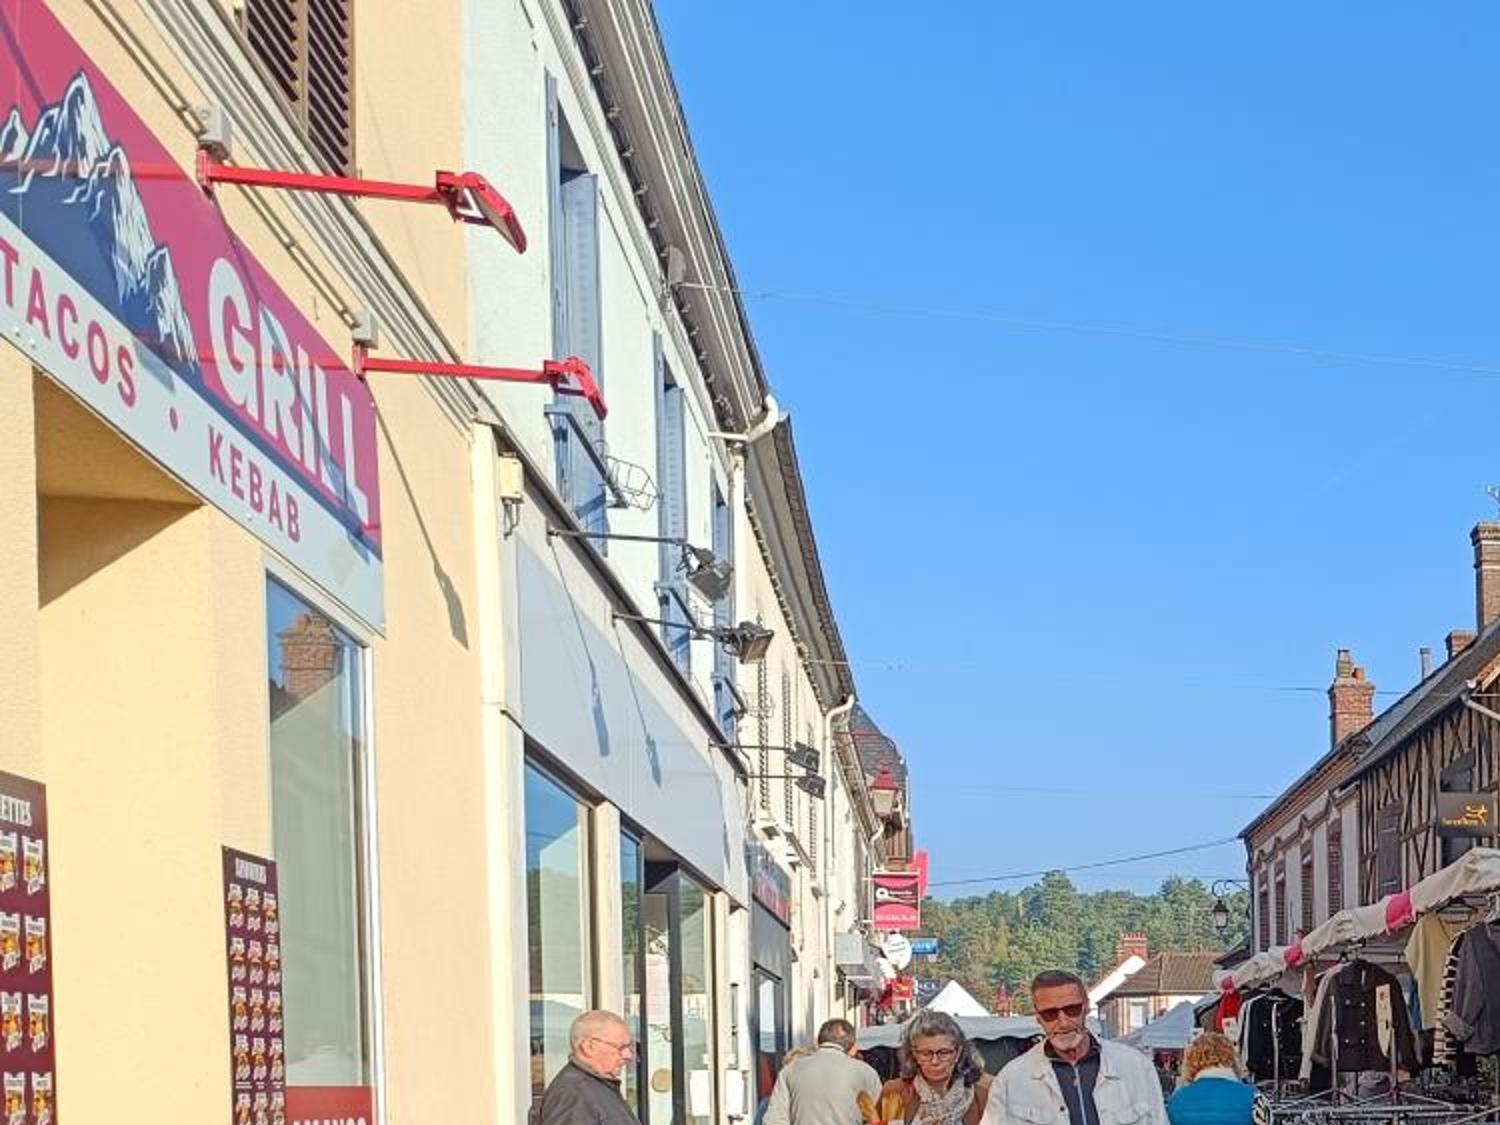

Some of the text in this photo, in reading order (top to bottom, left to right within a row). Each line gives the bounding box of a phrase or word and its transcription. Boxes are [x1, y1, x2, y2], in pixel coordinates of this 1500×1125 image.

[0, 236, 303, 543] TACOS KEBAB
[208, 257, 370, 524] GRILL
